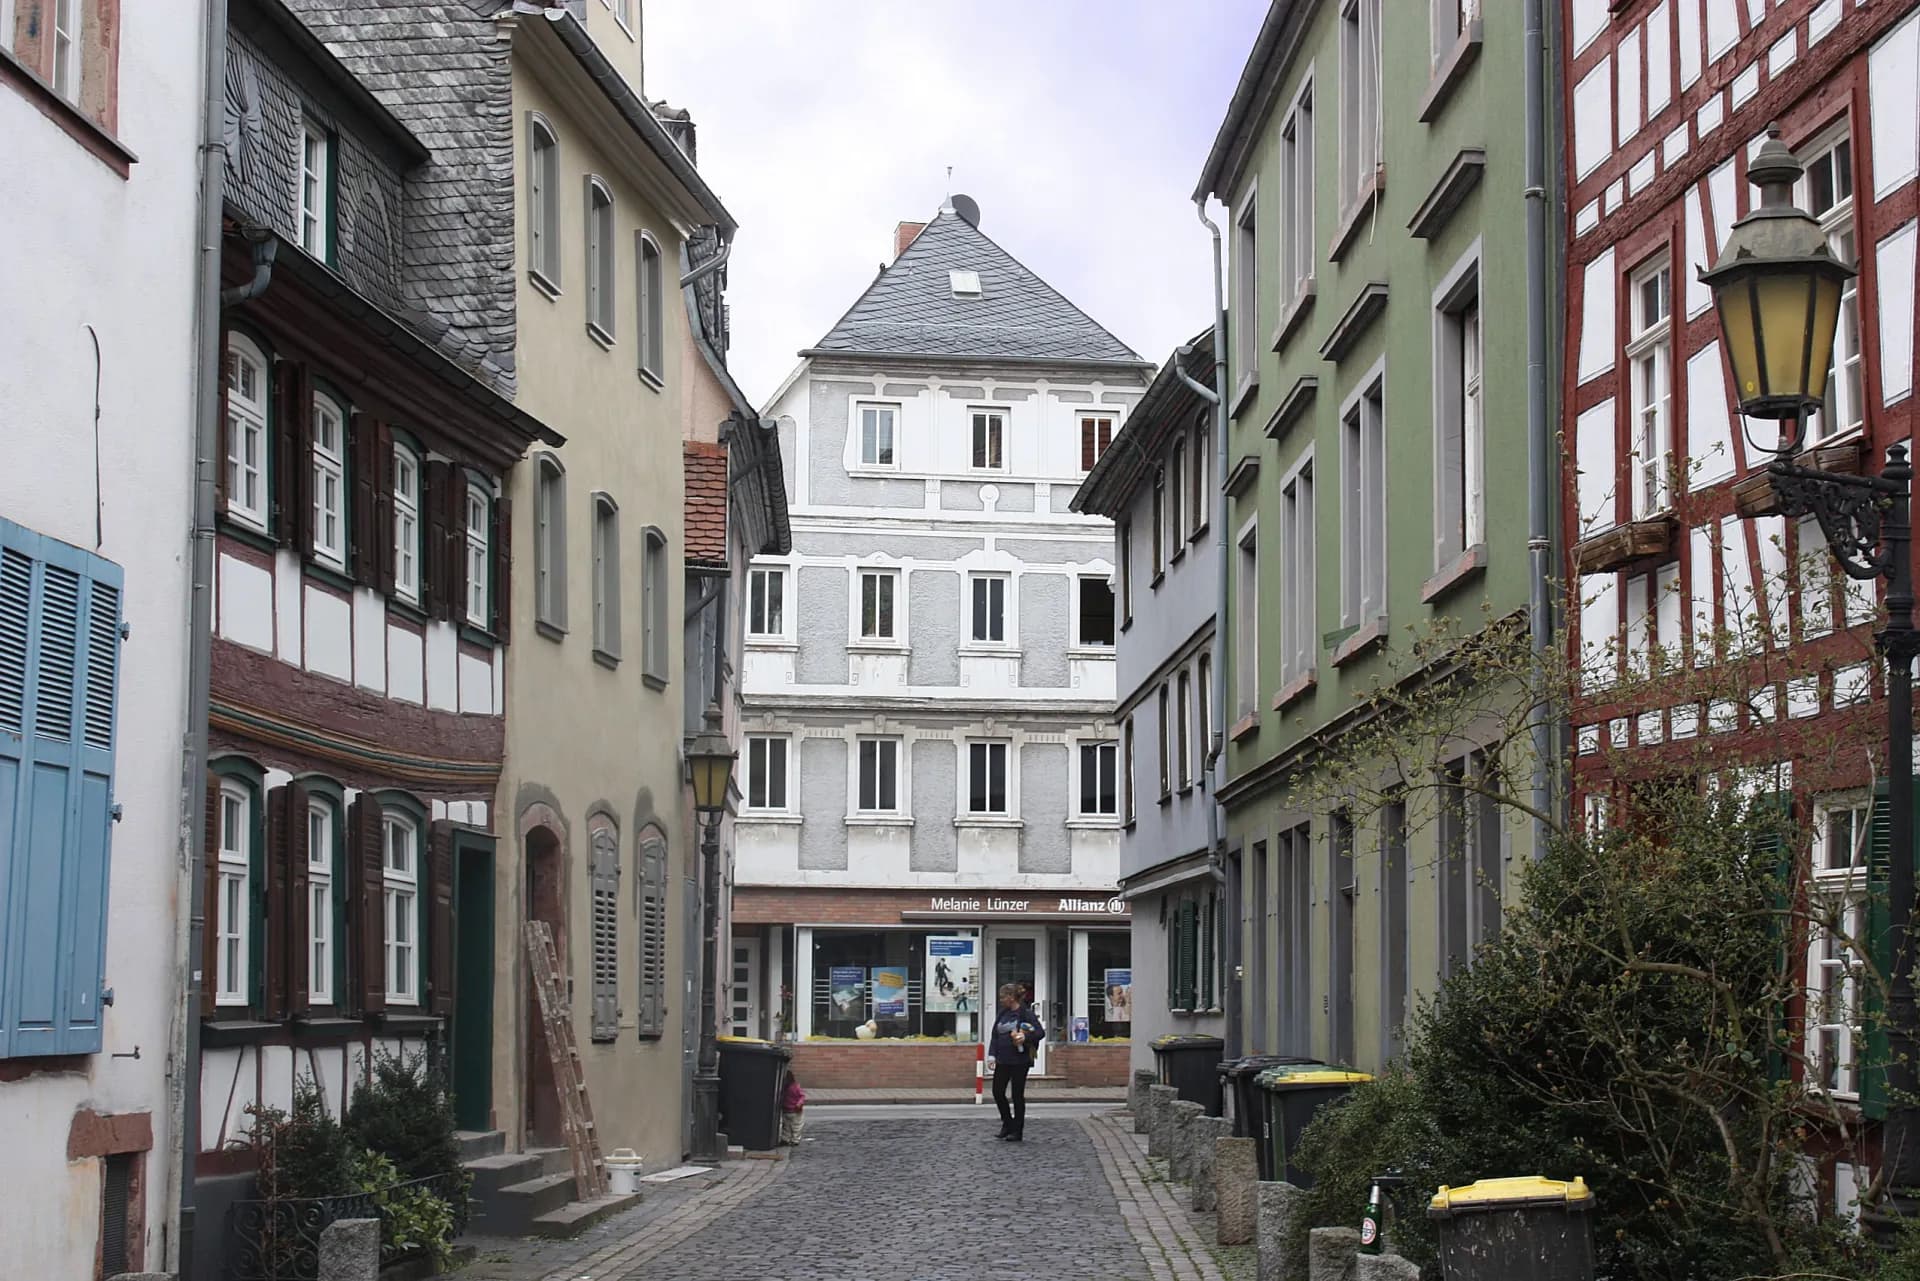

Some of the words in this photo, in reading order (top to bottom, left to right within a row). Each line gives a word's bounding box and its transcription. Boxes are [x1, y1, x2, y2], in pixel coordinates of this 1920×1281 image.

[931, 897, 980, 911] Melanie
[987, 897, 1029, 911] Lünzer
[1058, 898, 1105, 911] Allianz
